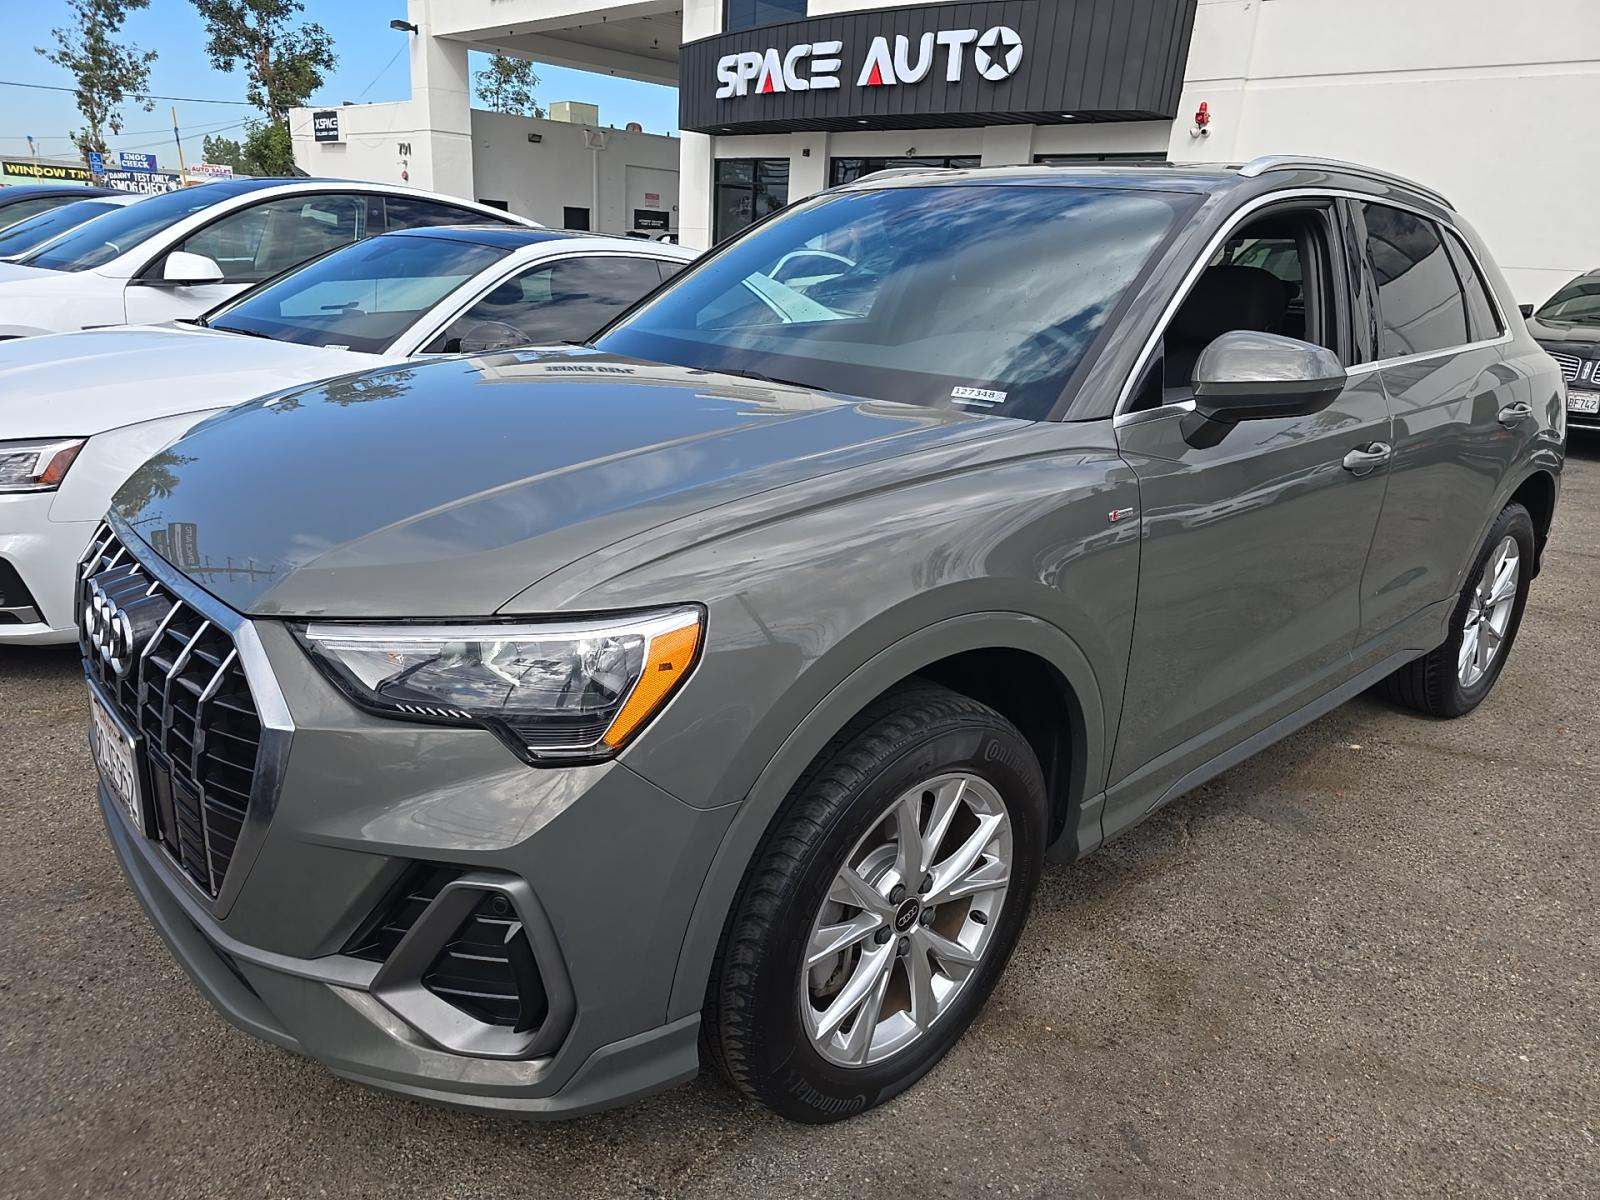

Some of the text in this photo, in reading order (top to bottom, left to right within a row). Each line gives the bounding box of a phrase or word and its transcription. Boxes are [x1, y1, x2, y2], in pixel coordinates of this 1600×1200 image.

[715, 25, 1024, 99] SPACE AUTO
[123, 153, 147, 161] SMOG
[121, 160, 150, 169] CHECK
[6, 164, 66, 177] WINDOW
[68, 169, 92, 179] TIN
[133, 173, 151, 182] TEST
[151, 174, 170, 184] ONLY
[110, 179, 138, 193] SMOG
[953, 387, 997, 399] 127348
[789, 1077, 867, 1116] Continental
